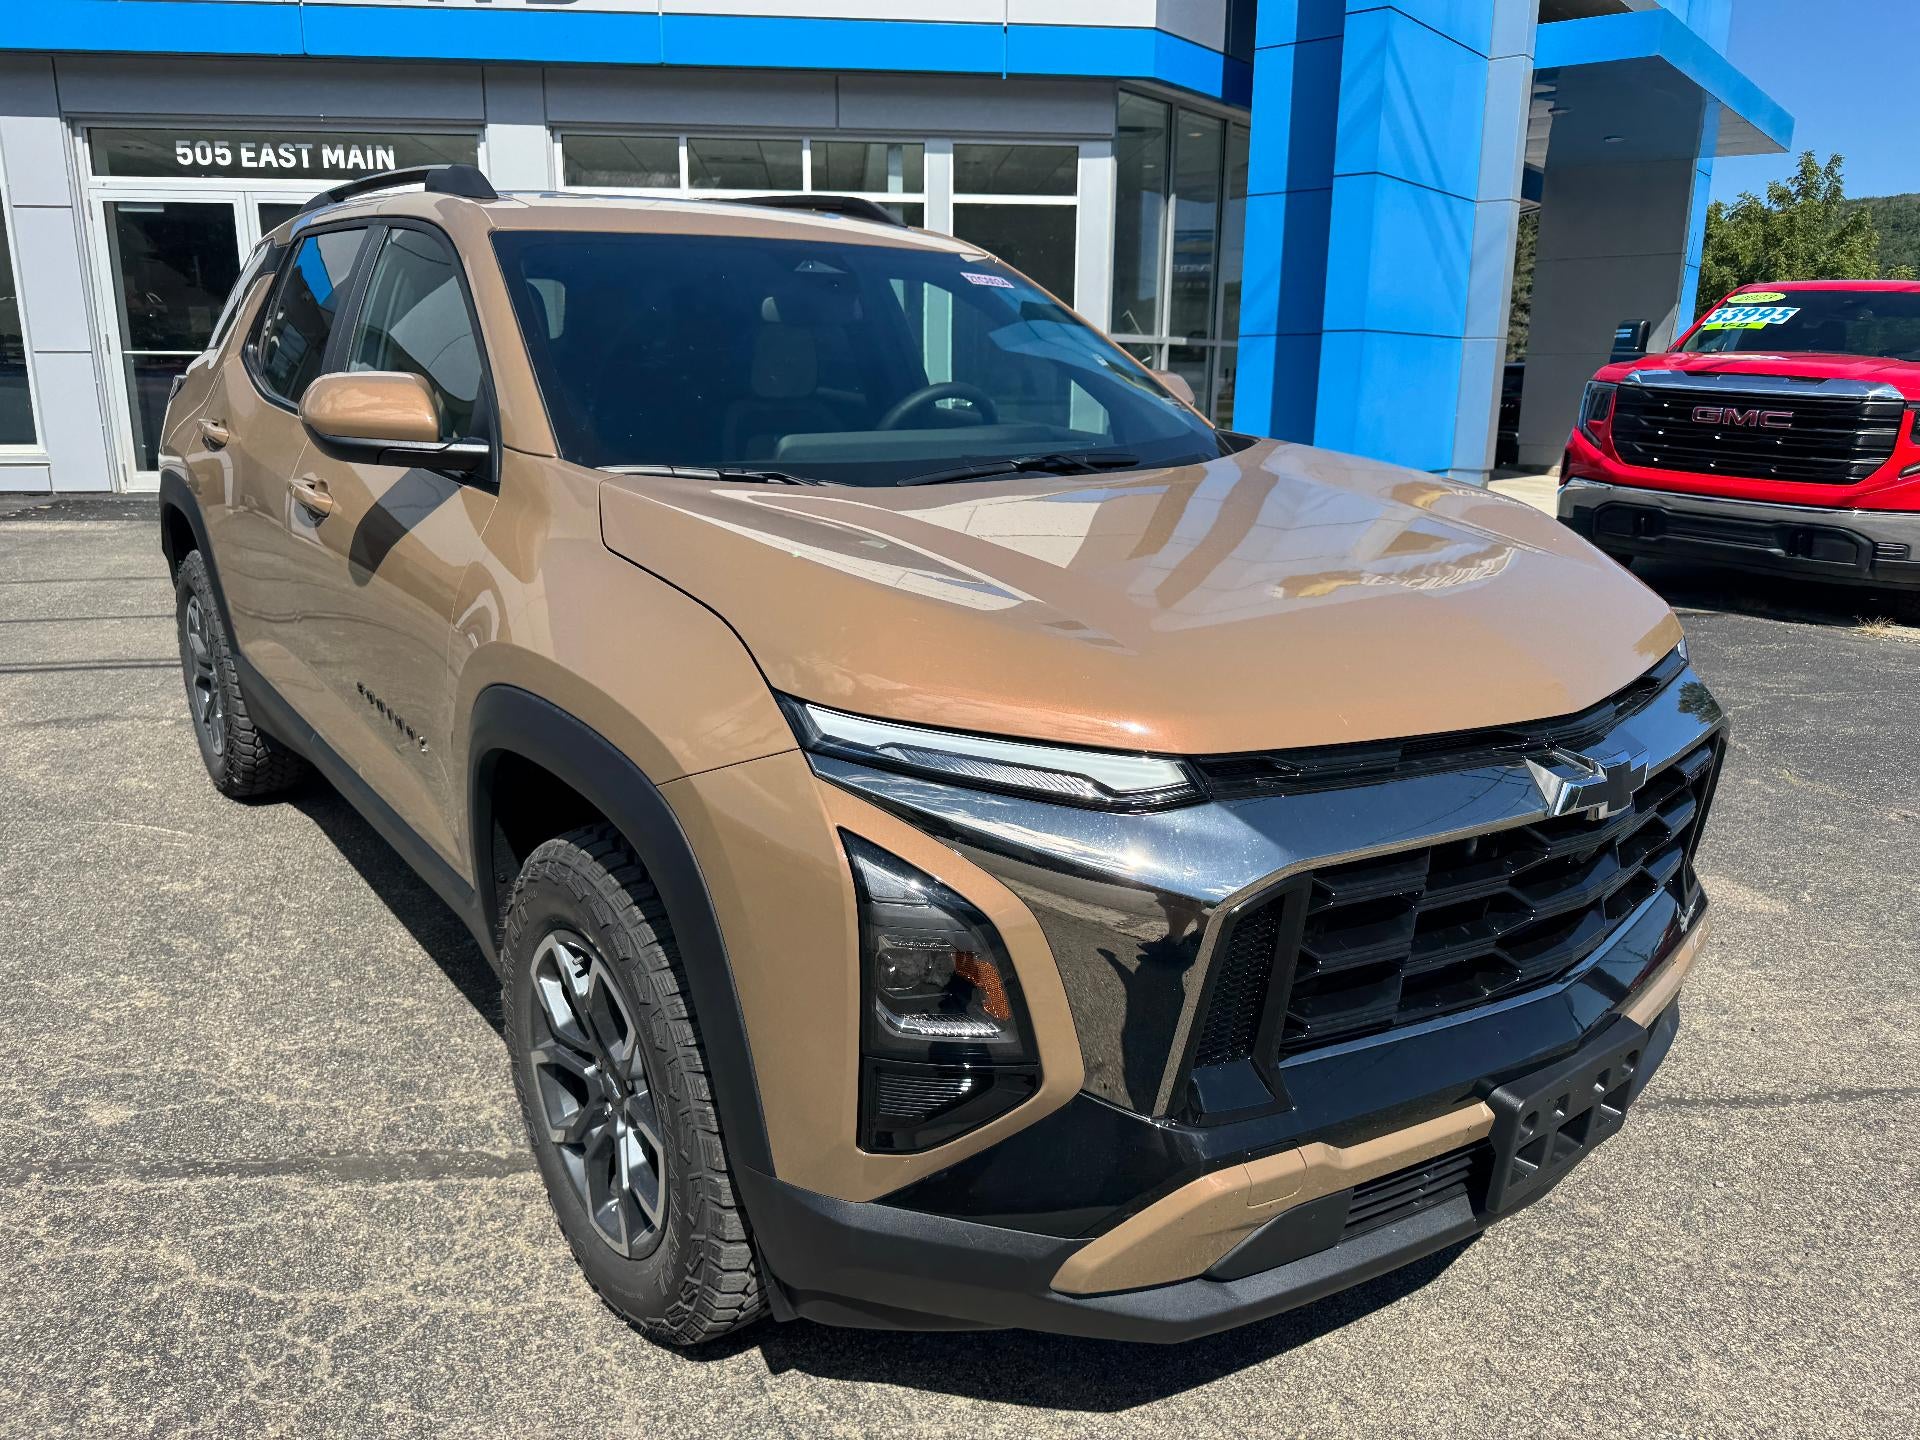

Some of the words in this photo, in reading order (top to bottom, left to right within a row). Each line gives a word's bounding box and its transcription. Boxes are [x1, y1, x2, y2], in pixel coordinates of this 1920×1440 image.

[175, 140, 233, 166] 505
[240, 142, 313, 168] EAST
[322, 144, 396, 170] MAIN
[1705, 307, 1796, 324] 33995
[1692, 406, 1794, 428] GMC
